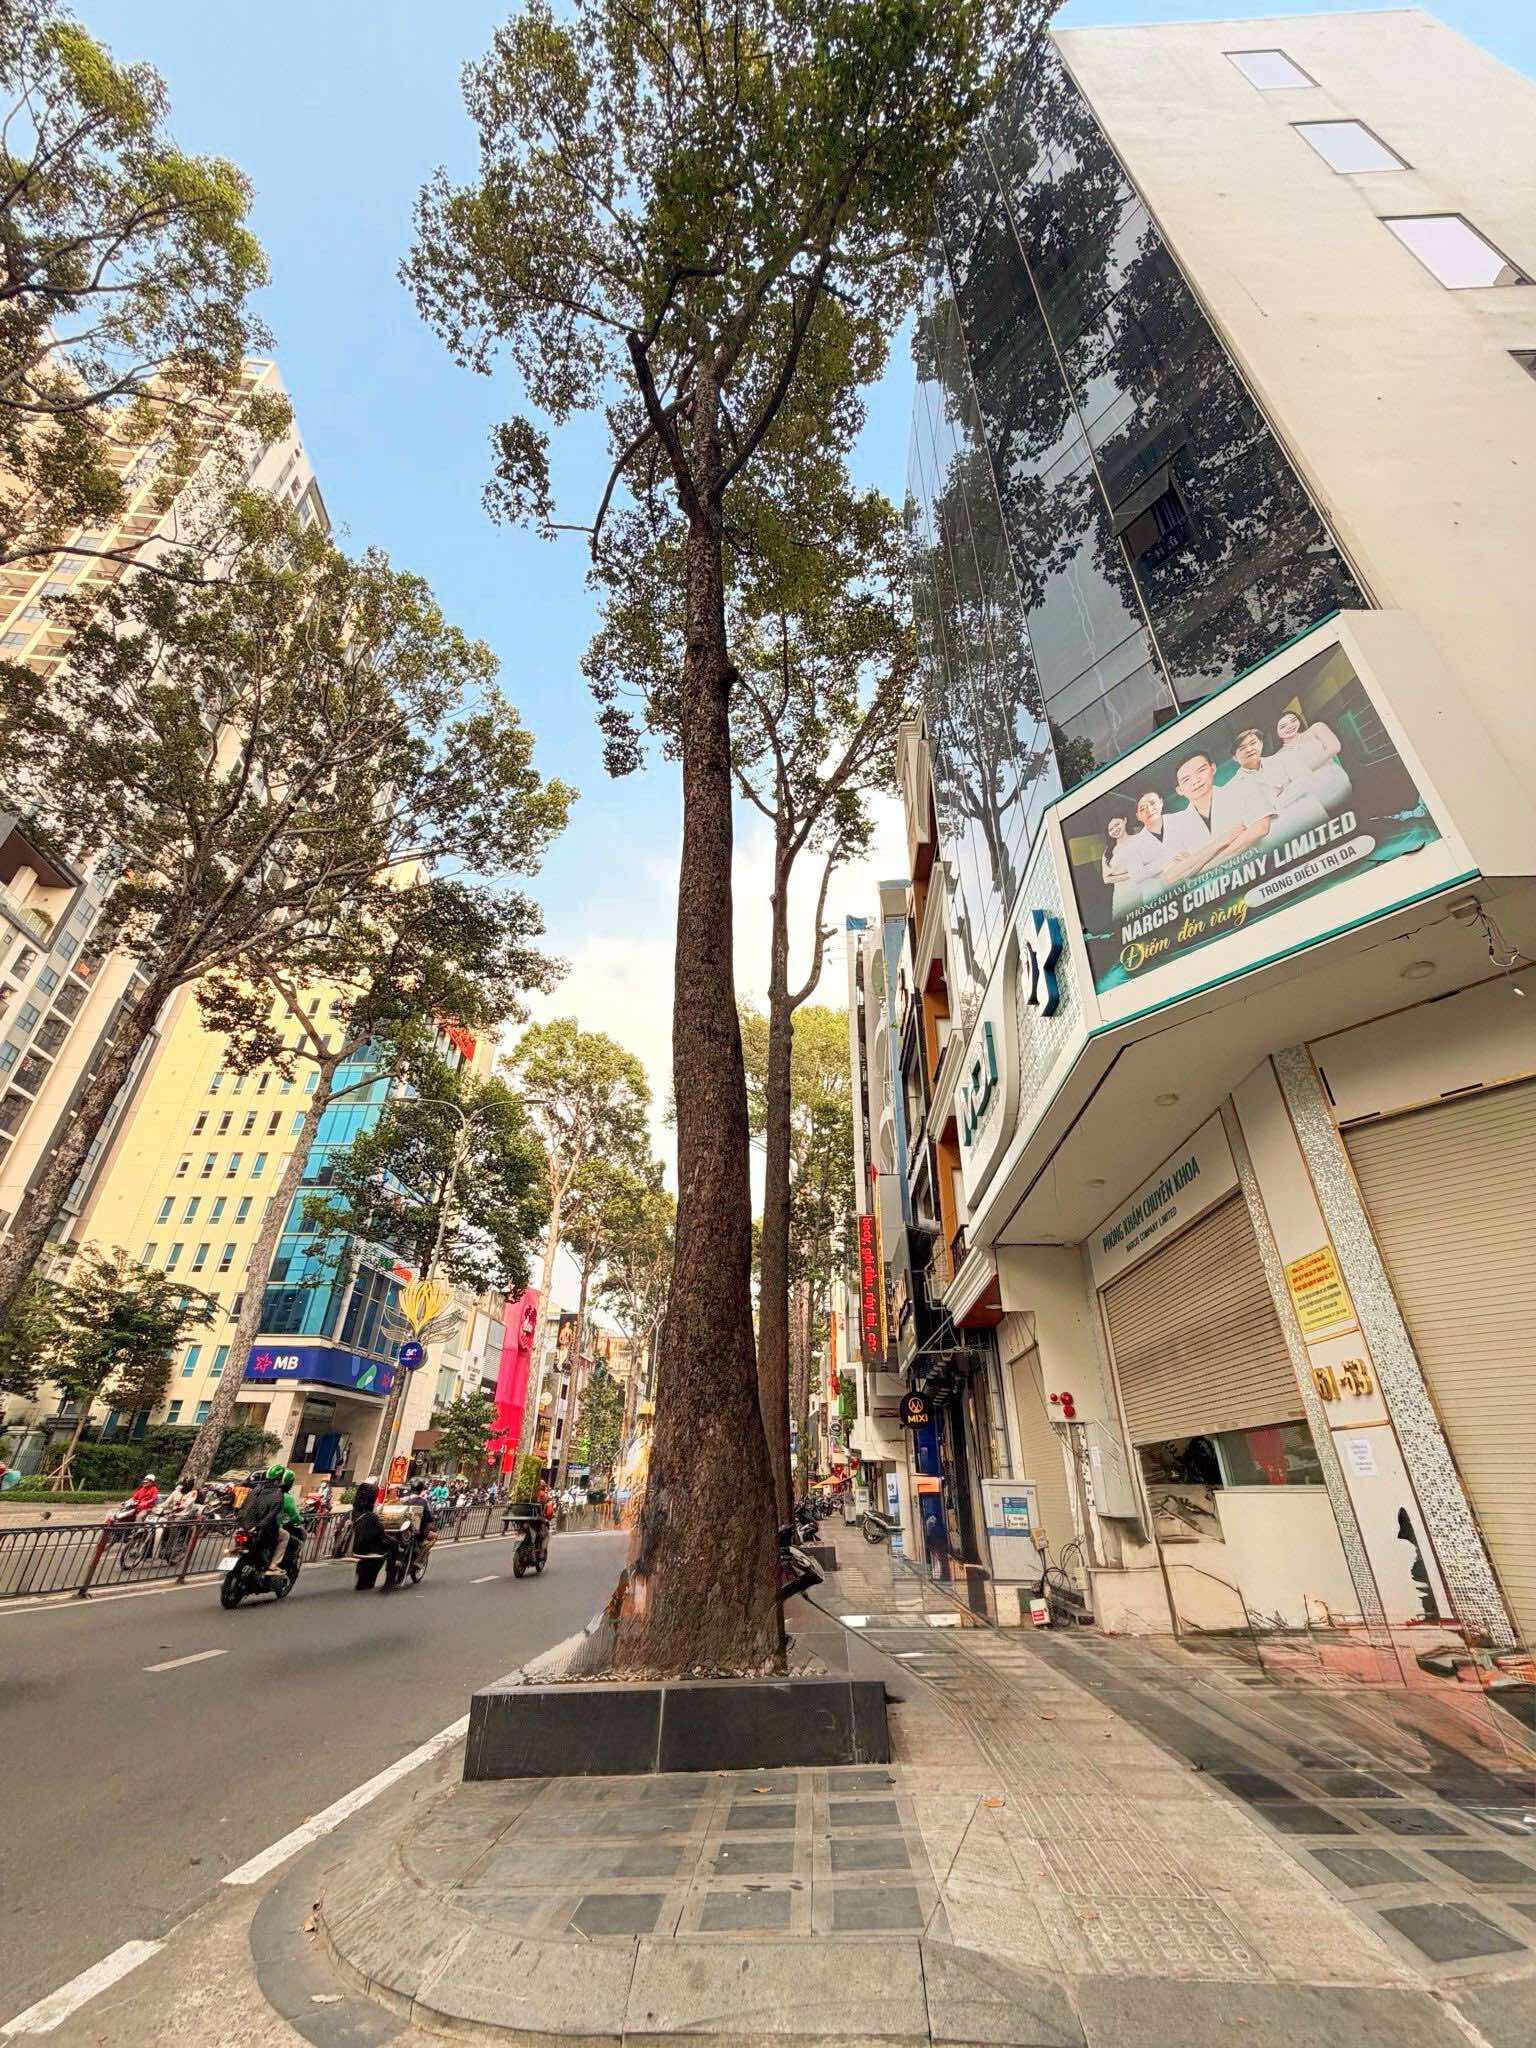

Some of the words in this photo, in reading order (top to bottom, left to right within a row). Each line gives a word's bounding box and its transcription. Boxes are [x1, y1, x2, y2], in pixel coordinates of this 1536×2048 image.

[1121, 901, 1180, 945] NARCIS
[1182, 856, 1268, 913] COMPANY
[1273, 811, 1358, 868] LIMITED
[1259, 874, 1293, 899] TRONG
[1342, 844, 1358, 862] DA
[1122, 1204, 1145, 1237] KHÁM
[1143, 1180, 1175, 1218] CHUYÊN
[1172, 1156, 1200, 1193] KHOA
[273, 1355, 299, 1370] MB
